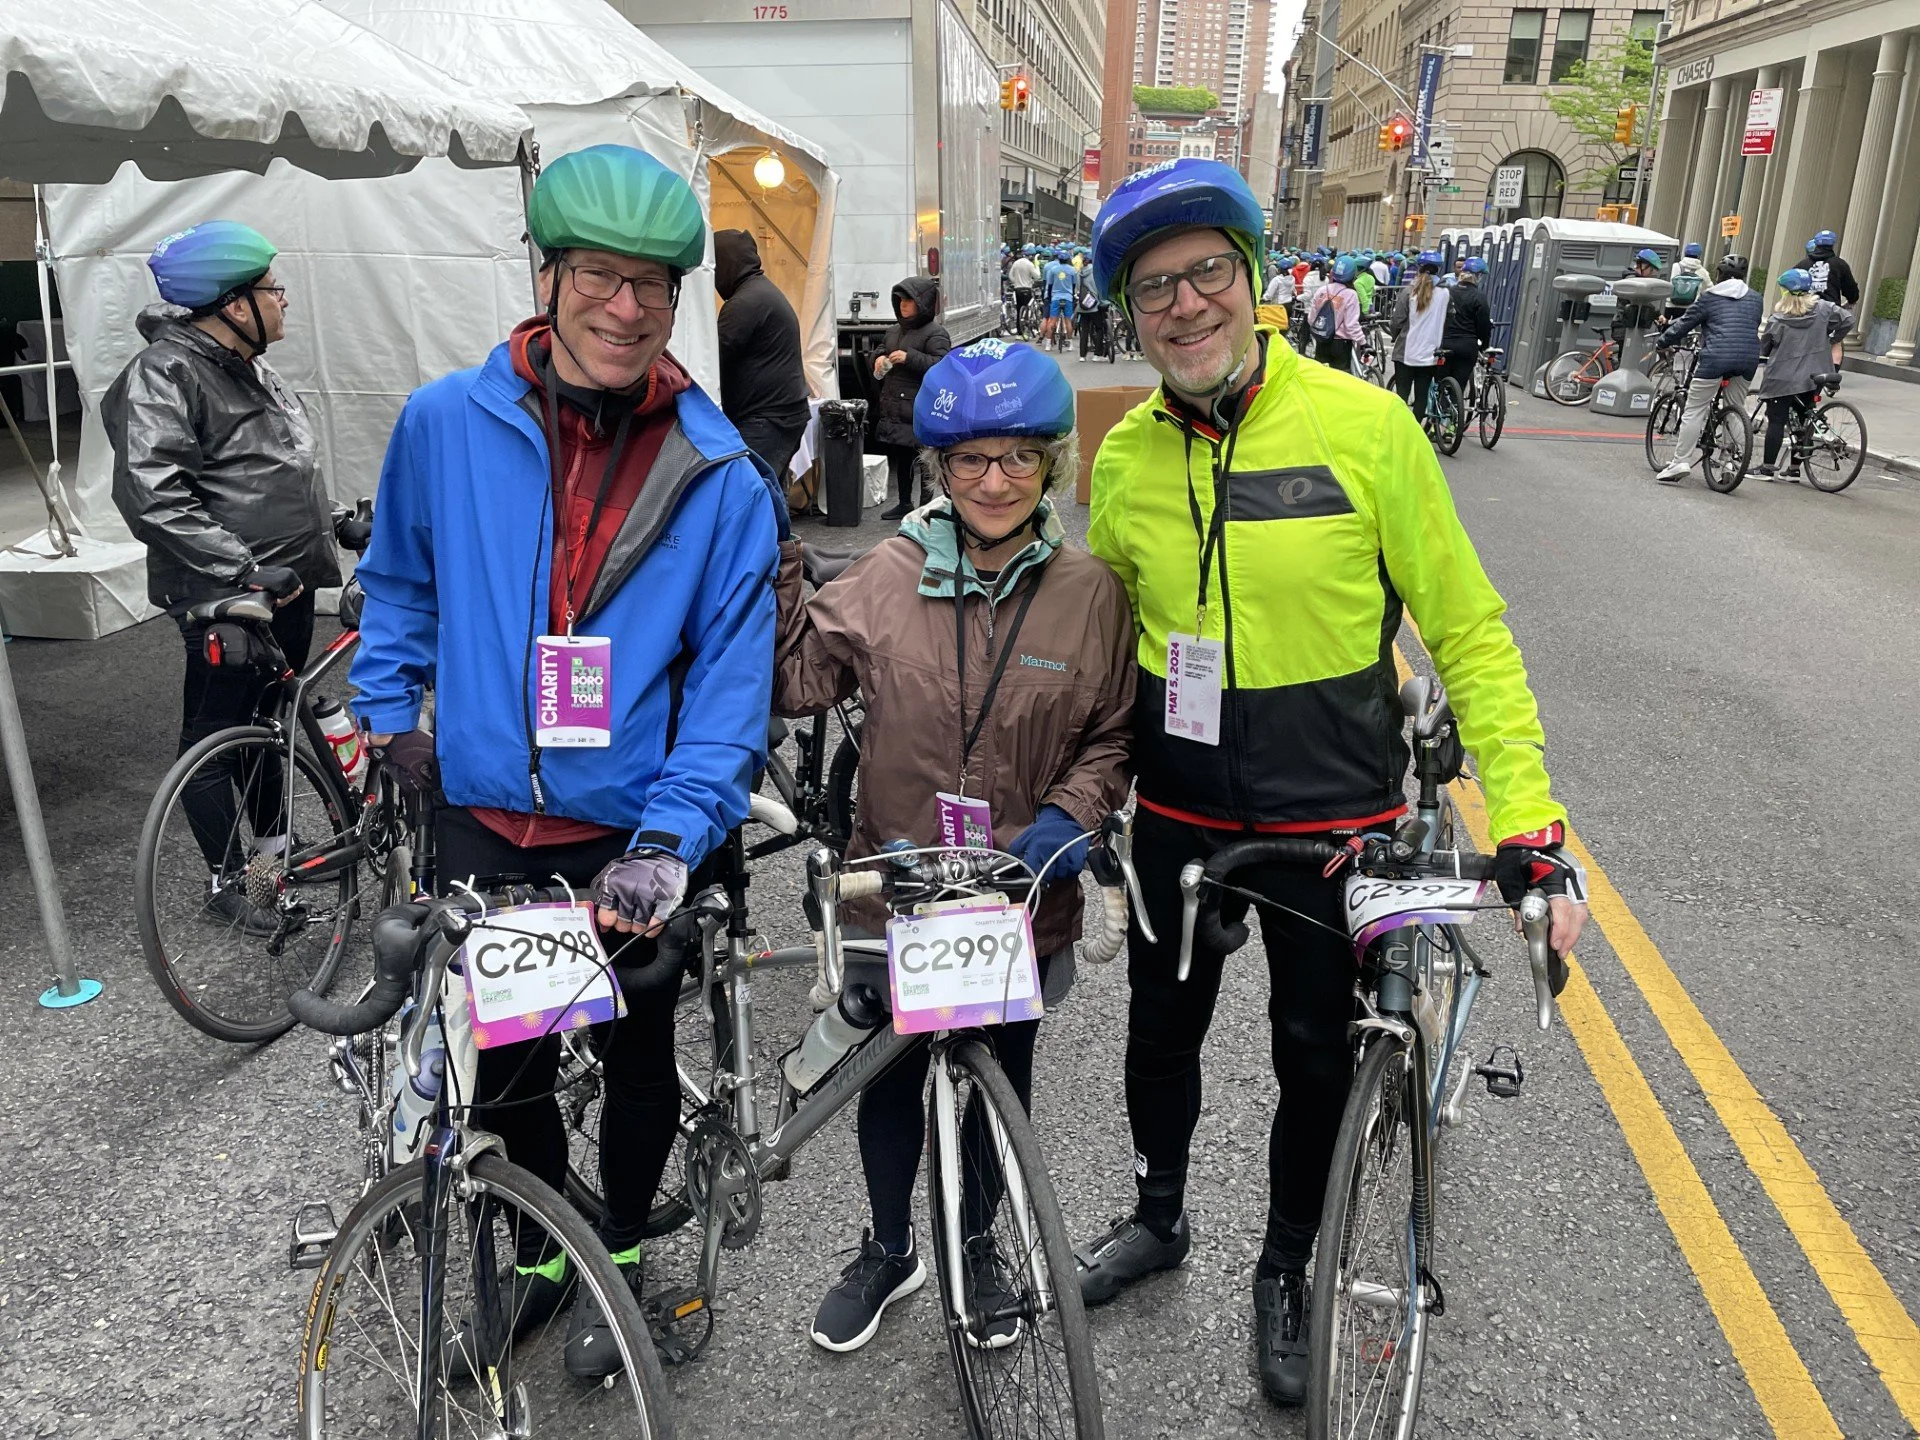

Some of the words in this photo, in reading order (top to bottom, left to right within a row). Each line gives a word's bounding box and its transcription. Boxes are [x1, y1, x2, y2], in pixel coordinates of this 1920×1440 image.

[753, 5, 788, 19] 1775
[1677, 60, 1707, 85] CHASE
[1415, 89, 1426, 124] YORK
[1499, 169, 1522, 180] STOP
[1499, 187, 1517, 198] RED
[1020, 654, 1067, 672] Marmot
[1169, 642, 1180, 674] 2024
[571, 666, 604, 677] FIVE
[541, 646, 558, 726] CHARITY
[571, 676, 604, 686] BORO
[571, 685, 604, 694] BIKE
[571, 693, 604, 704] TOUR
[1168, 690, 1178, 715] MAY
[964, 829, 988, 843] BORO
[1348, 883, 1471, 911] C2997
[475, 930, 599, 979] C2998
[899, 931, 1023, 974] C2999
